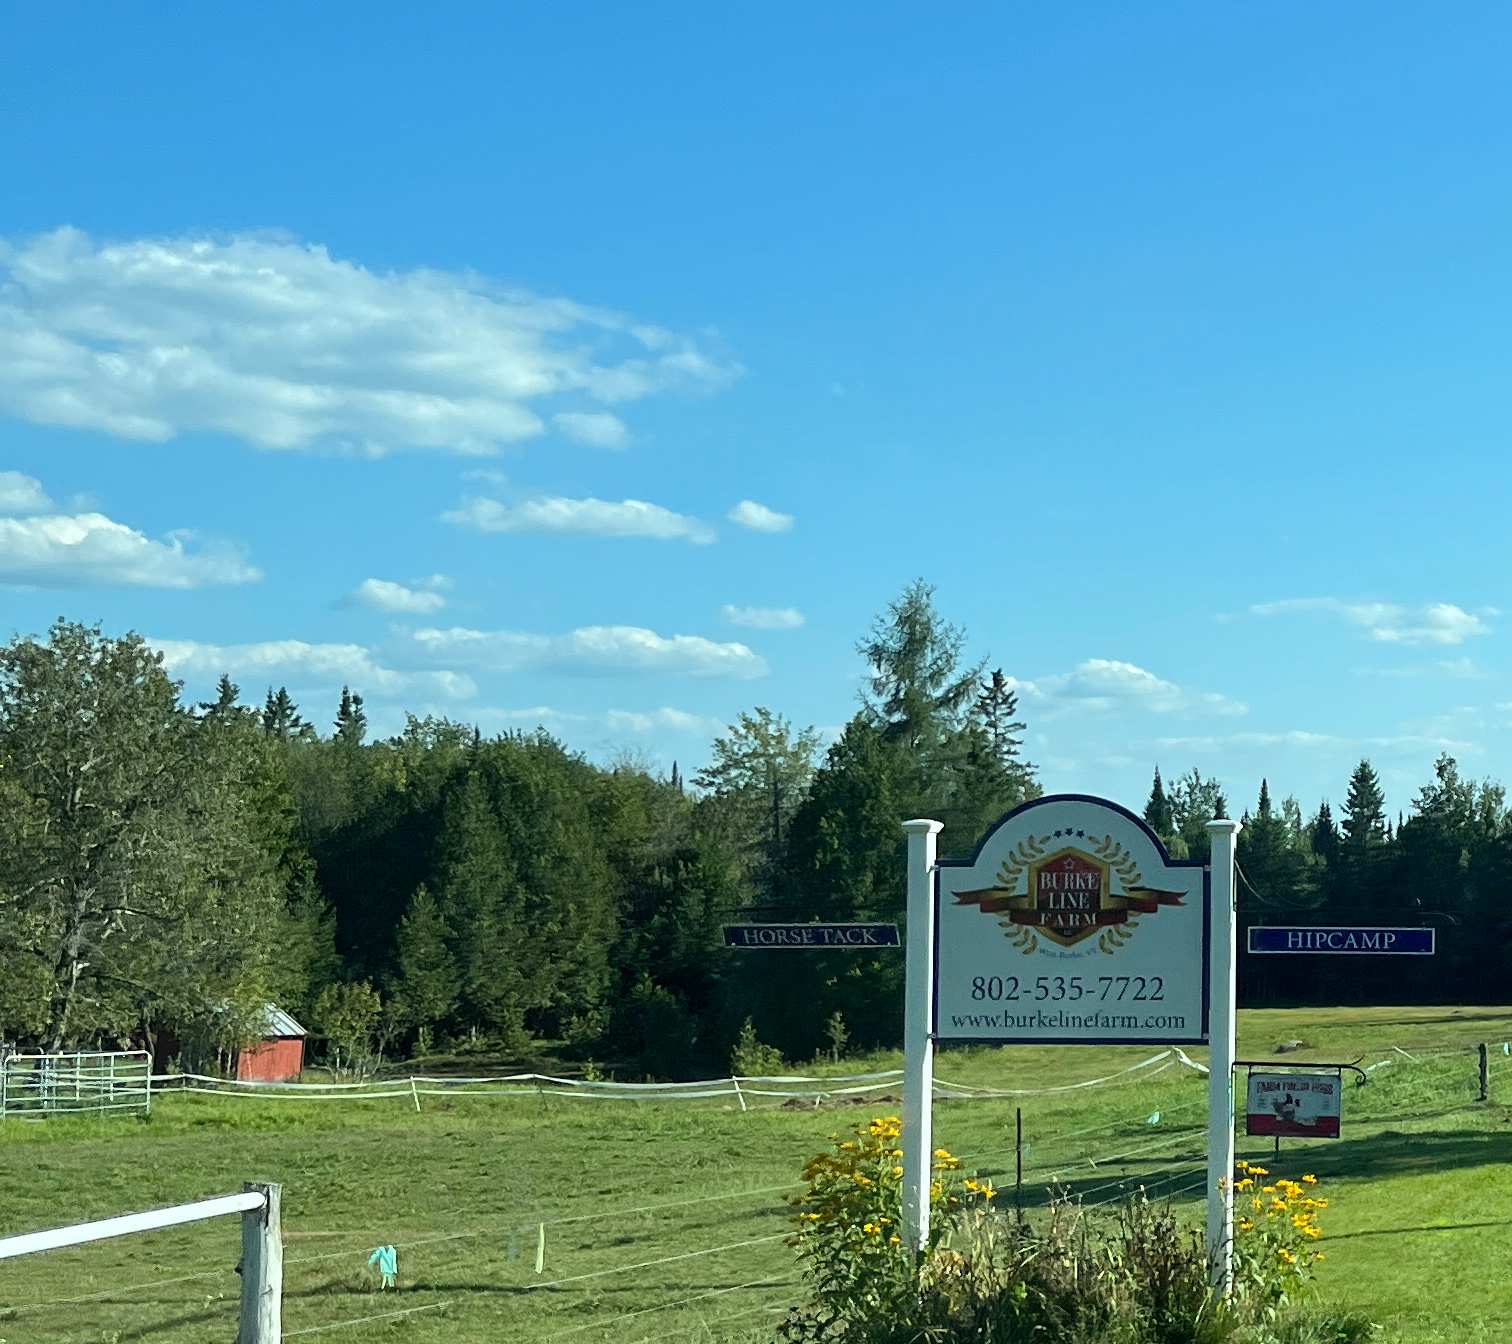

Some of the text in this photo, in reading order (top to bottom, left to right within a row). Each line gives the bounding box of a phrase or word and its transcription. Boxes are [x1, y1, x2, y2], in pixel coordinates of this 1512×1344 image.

[1040, 871, 1100, 890] BURKE
[1049, 892, 1090, 909] LINE
[1040, 912, 1097, 928] FARM
[743, 927, 878, 945] HORSE TACK
[1287, 931, 1396, 949] HIPCAMP
[971, 976, 1165, 1001] 802-535-7722
[951, 1009, 1185, 1029] www.burkelinefarm.com
